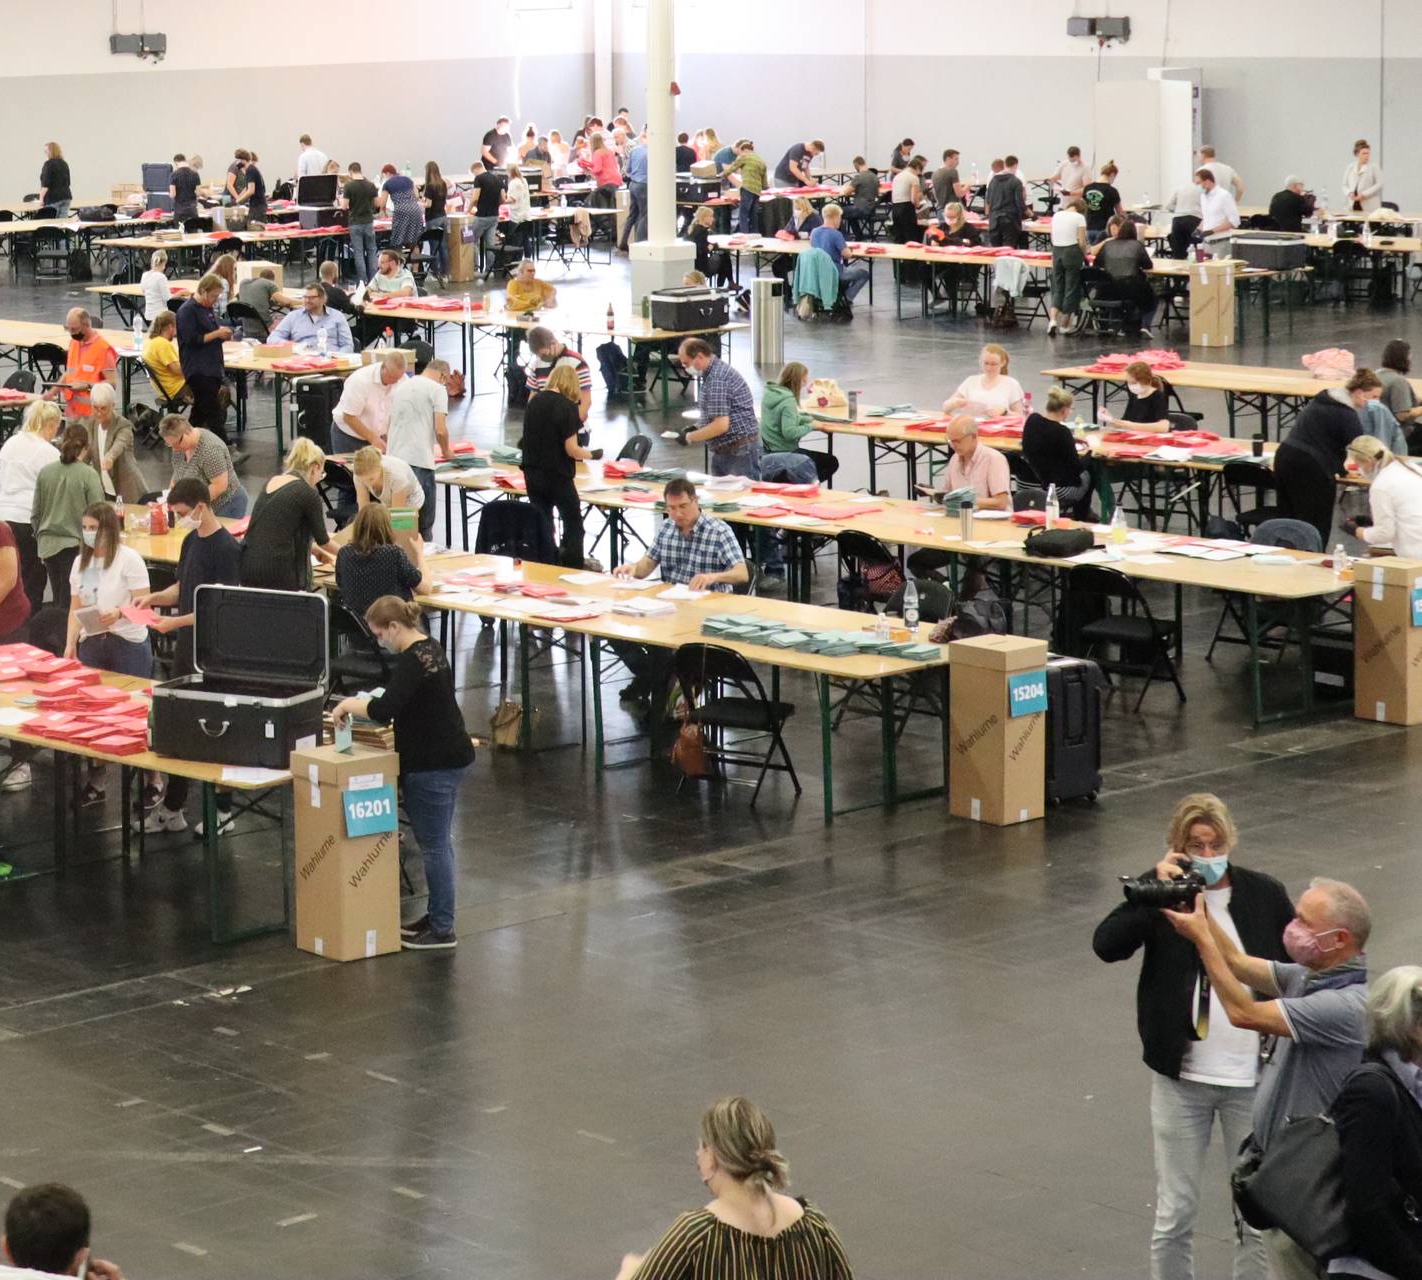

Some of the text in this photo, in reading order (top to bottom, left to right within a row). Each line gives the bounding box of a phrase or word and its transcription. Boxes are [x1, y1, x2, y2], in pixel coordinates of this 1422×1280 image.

[1012, 682, 1045, 703] 15204
[955, 713, 999, 756] Wahlurne
[348, 798, 391, 820] 16201
[299, 834, 336, 881] Wahlurne
